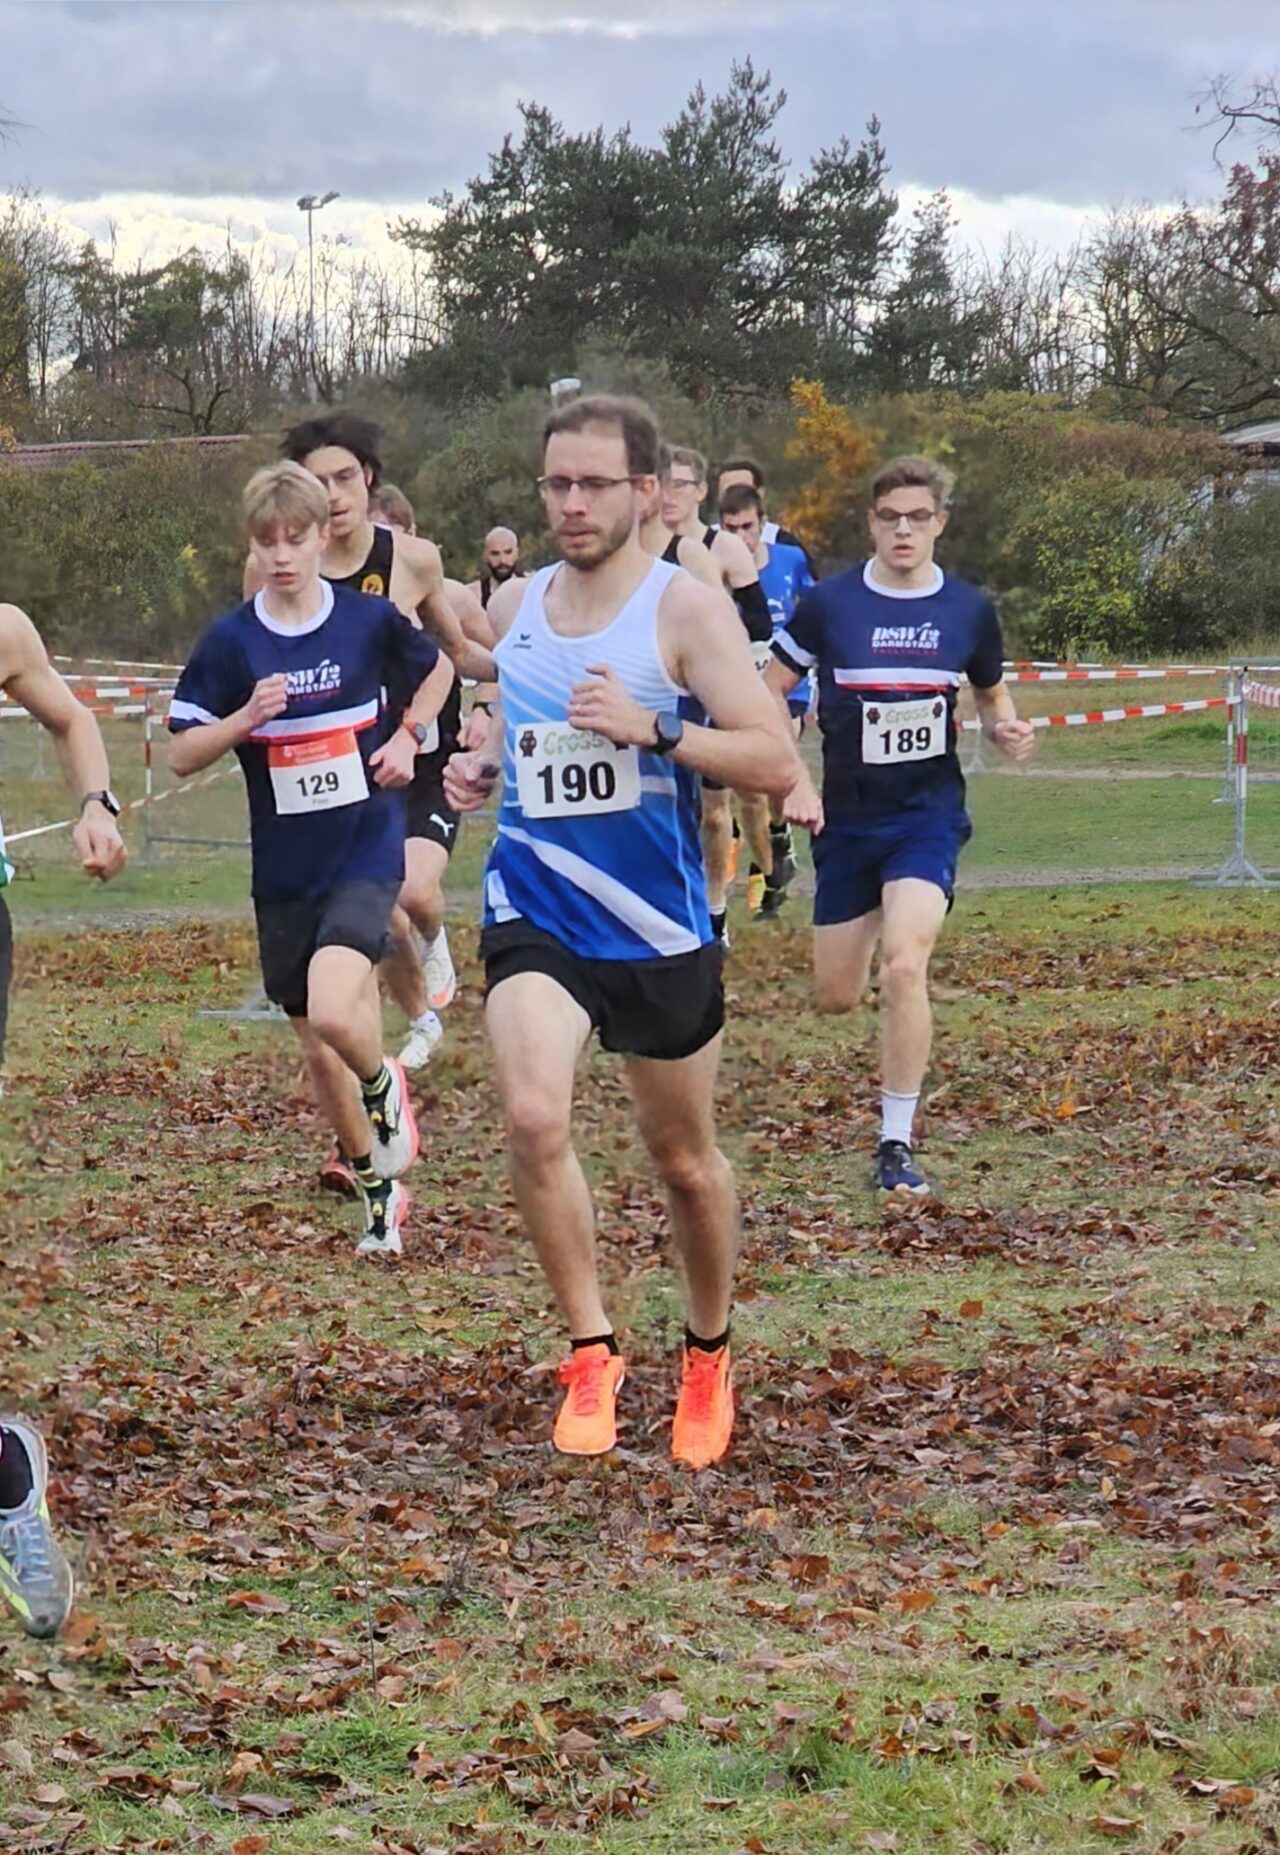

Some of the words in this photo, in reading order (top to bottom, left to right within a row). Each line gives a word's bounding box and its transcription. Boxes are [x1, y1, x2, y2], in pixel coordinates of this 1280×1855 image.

[885, 706, 929, 724] Cross
[879, 726, 931, 755] 189
[296, 771, 340, 797] 129
[537, 761, 616, 804] 190
